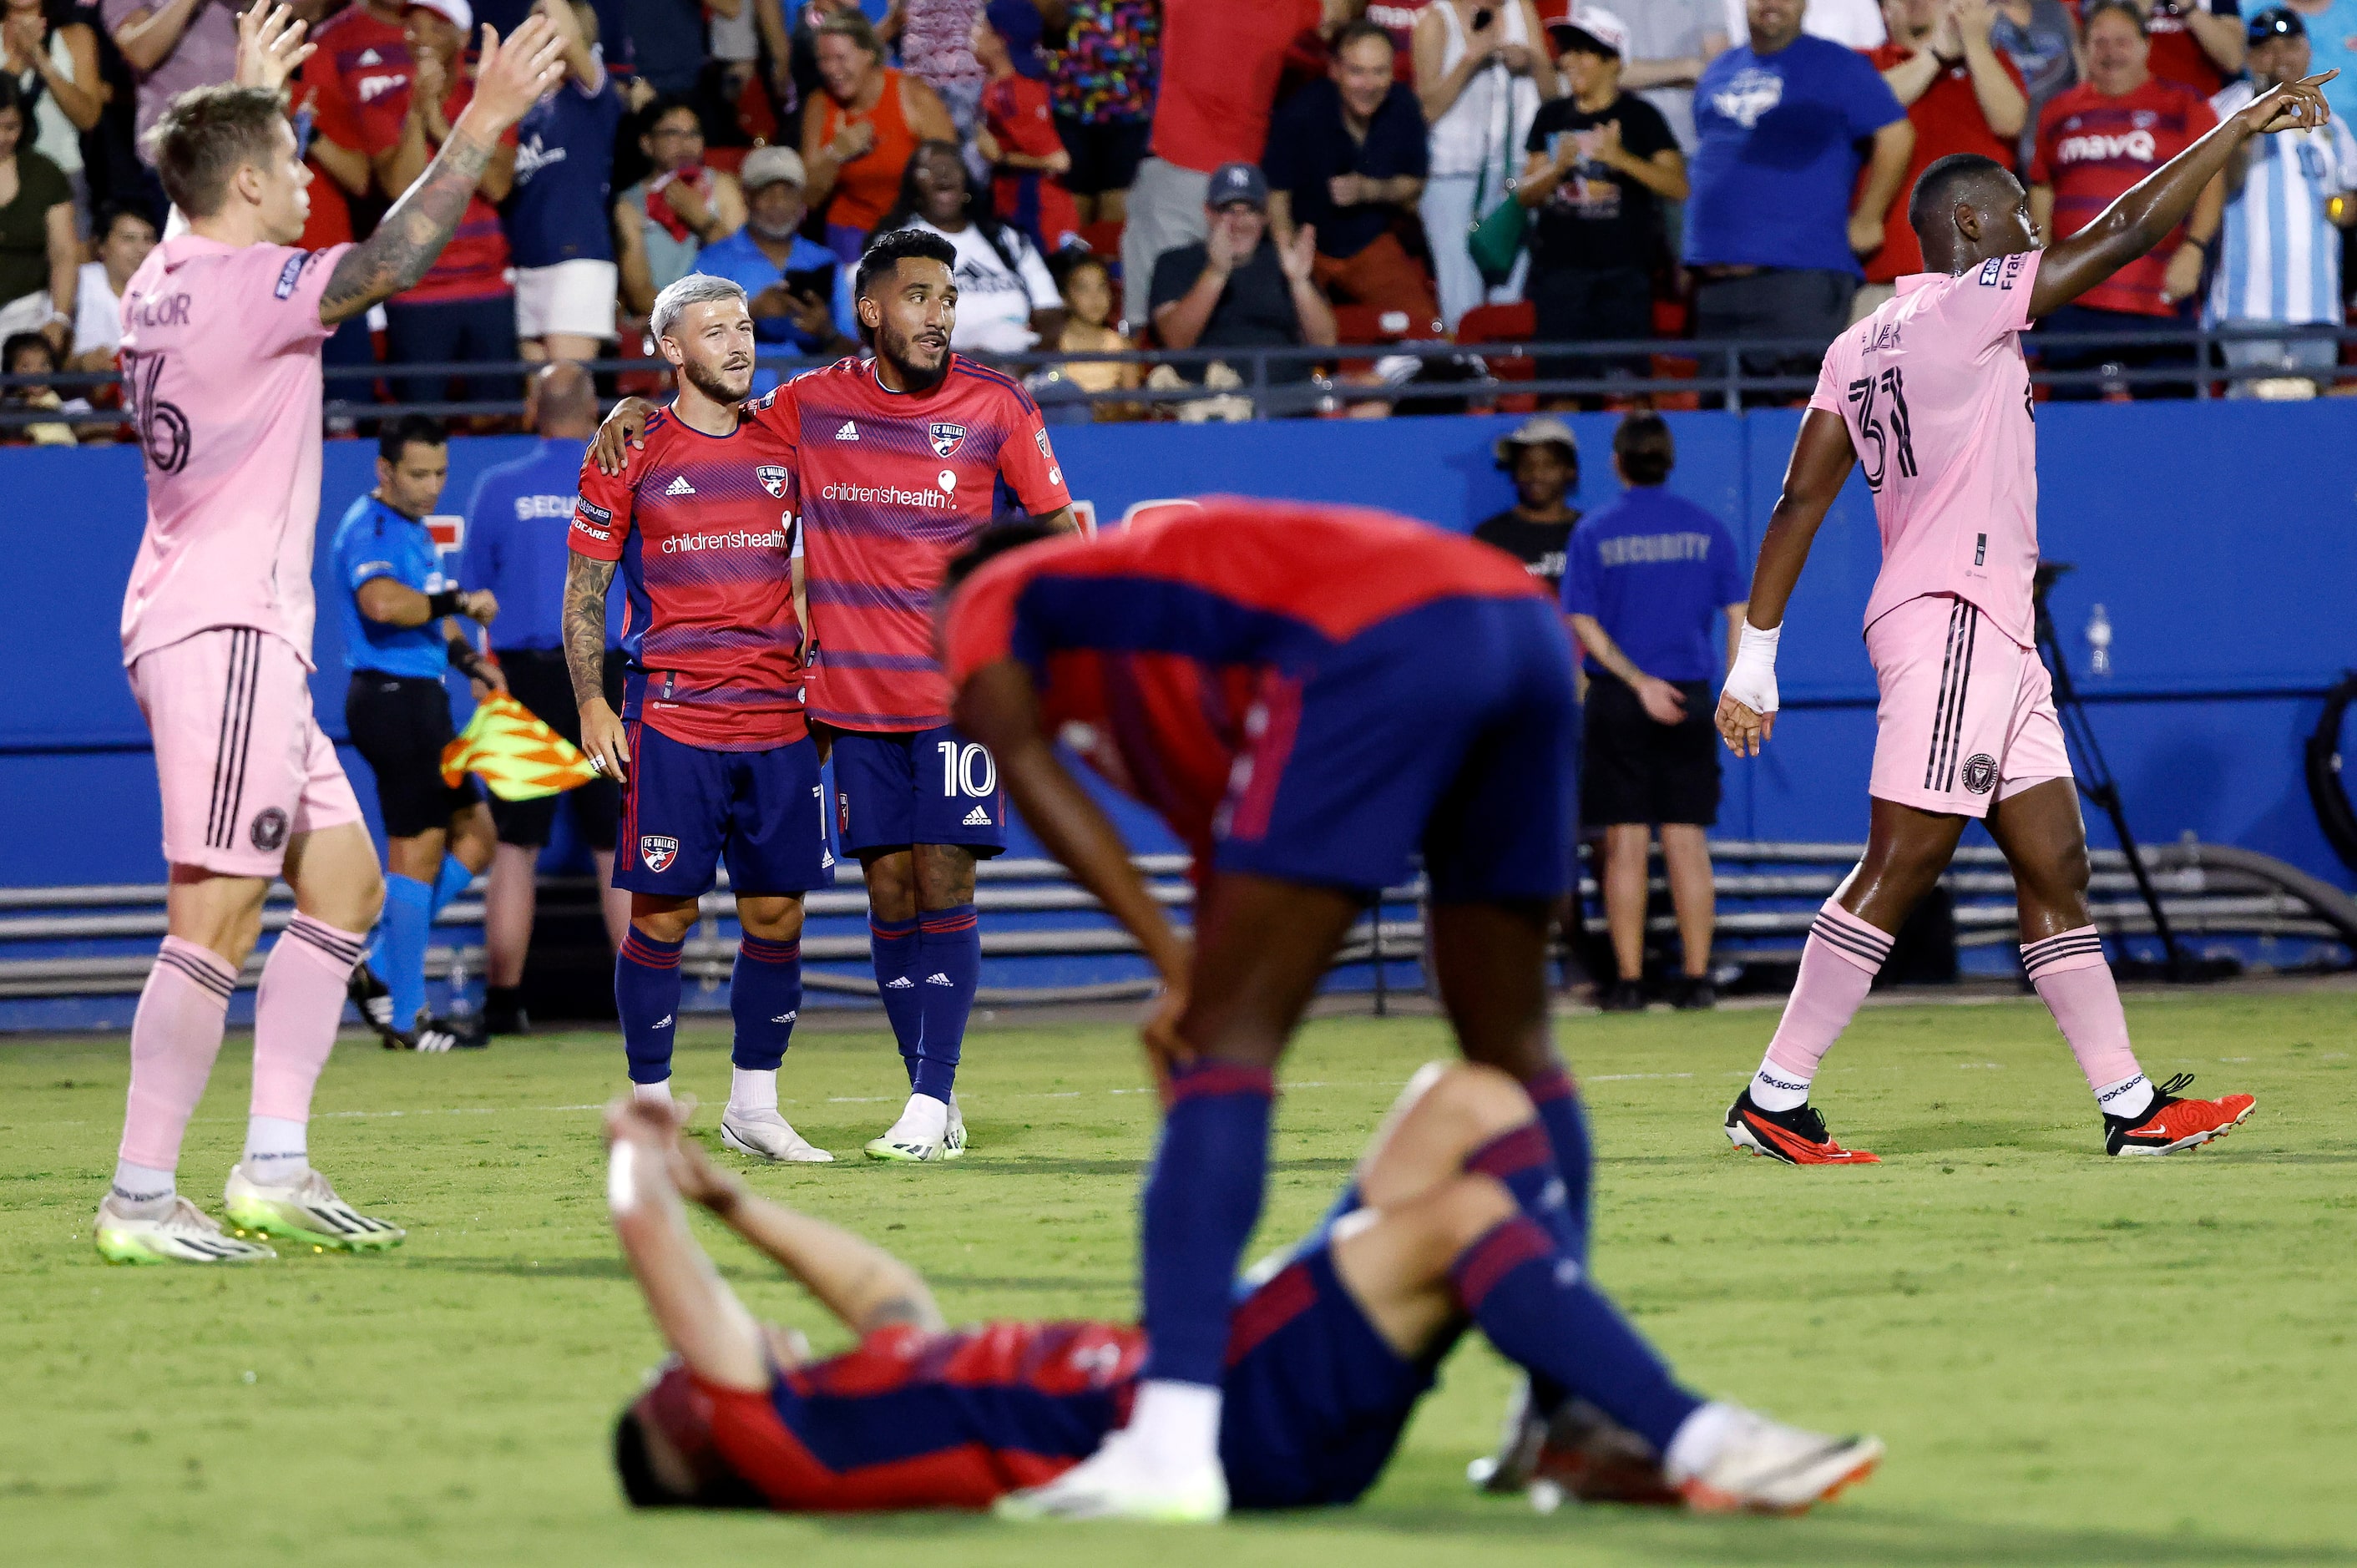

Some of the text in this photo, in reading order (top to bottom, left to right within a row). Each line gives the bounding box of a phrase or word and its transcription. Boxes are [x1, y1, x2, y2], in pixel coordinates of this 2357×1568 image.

[942, 425, 964, 437] DALLAS
[1848, 366, 1918, 494] 31
[665, 487, 696, 496] adidas
[1600, 534, 1710, 567] SECURITY
[937, 741, 997, 797] 10
[963, 817, 992, 826] adidas
[653, 838, 675, 850] DALLAS
